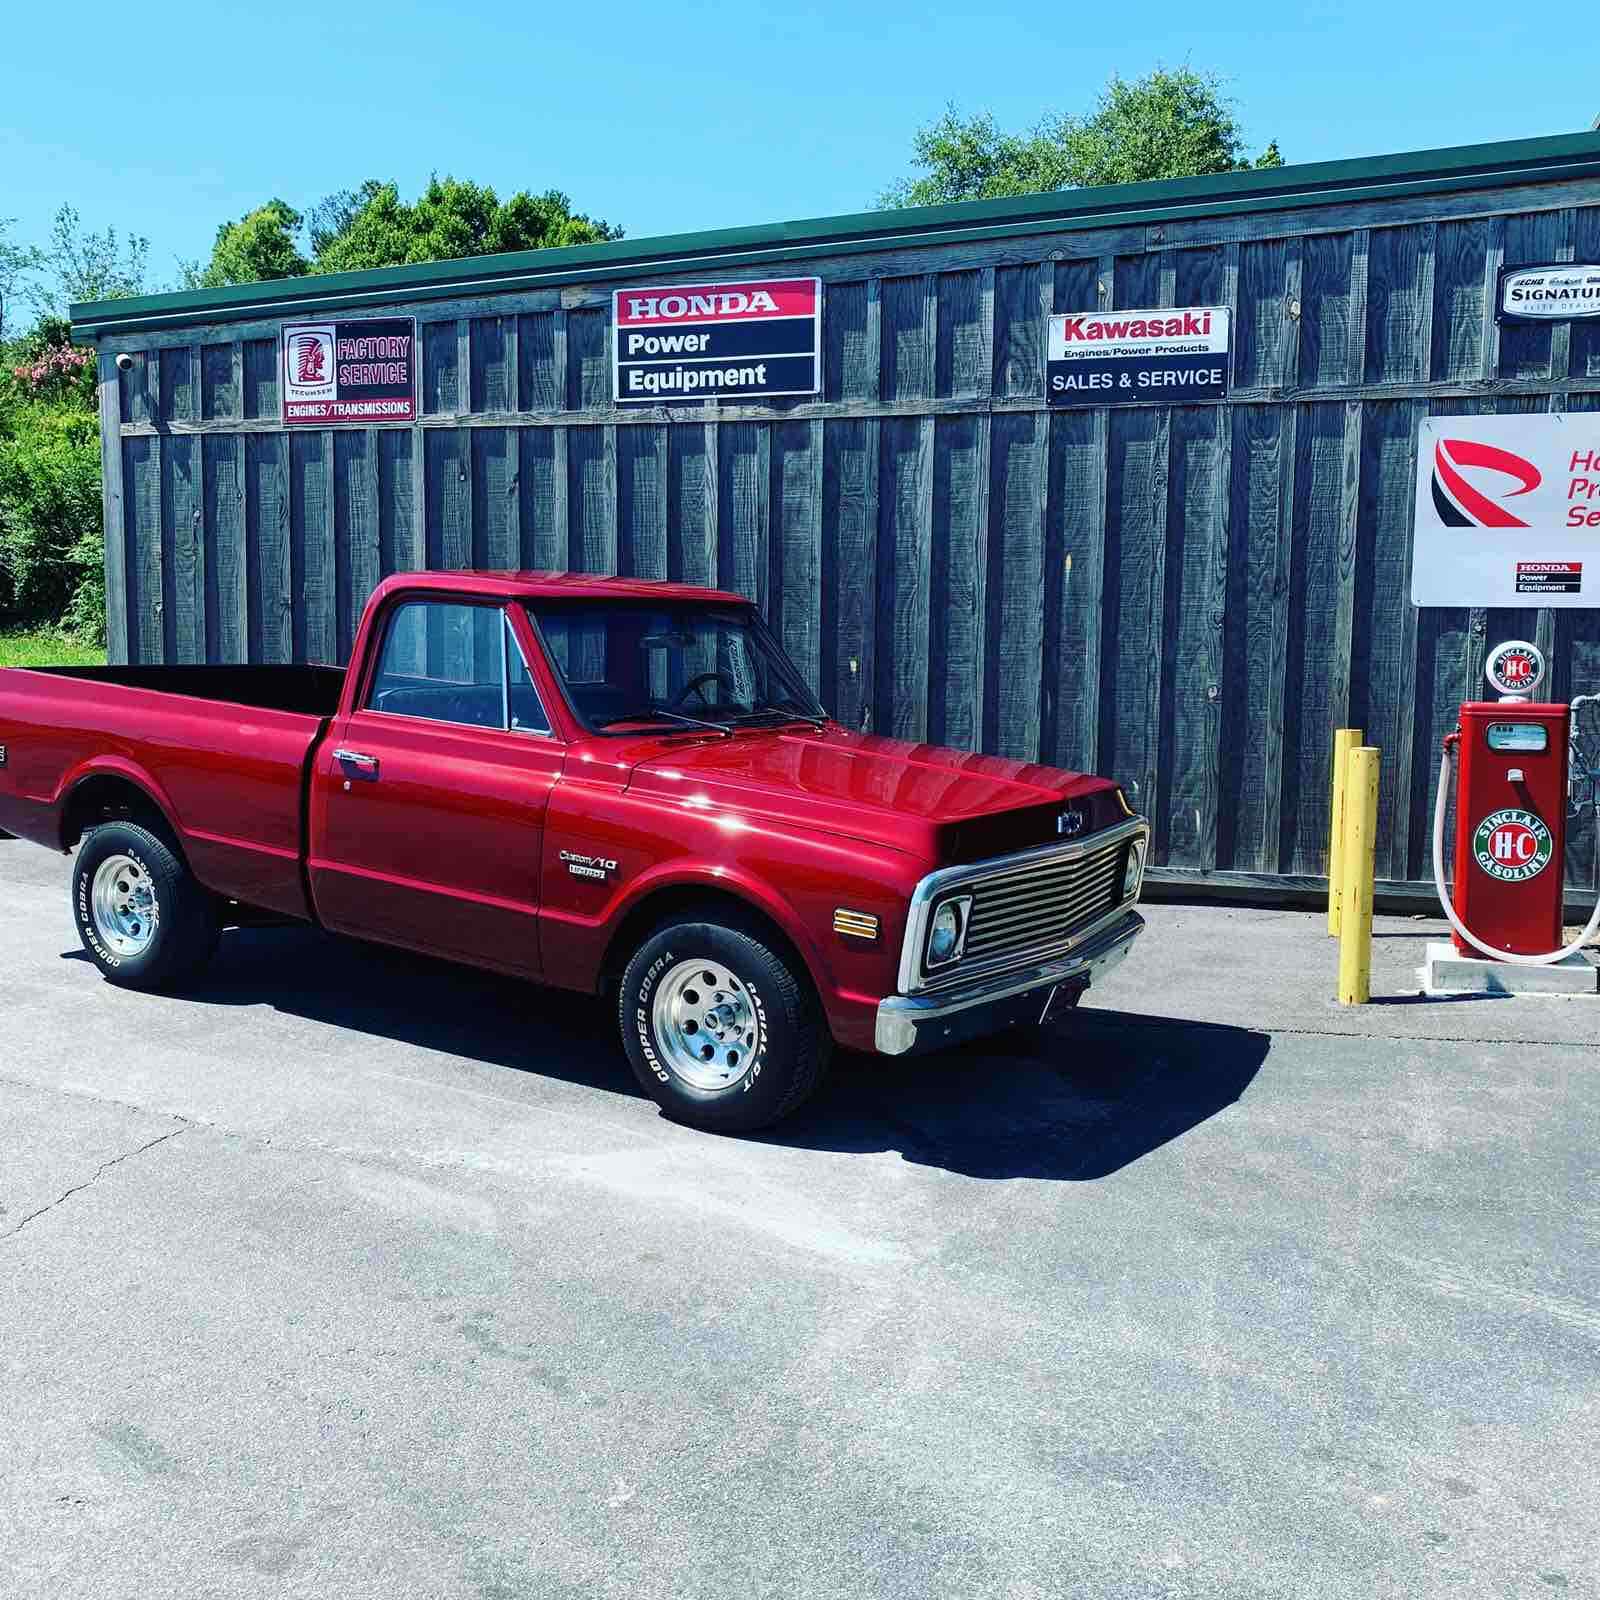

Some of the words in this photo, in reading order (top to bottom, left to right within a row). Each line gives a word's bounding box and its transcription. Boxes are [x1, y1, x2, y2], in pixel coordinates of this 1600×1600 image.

[627, 290, 779, 320] HONDA
[1064, 311, 1211, 342] Kawasaki
[337, 336, 410, 361] FACTORY
[628, 333, 710, 355] Power
[1155, 344, 1209, 354] Products
[339, 362, 408, 386] SERVICE
[628, 363, 767, 393] Equipment
[1052, 373, 1113, 391] SALES
[1119, 373, 1132, 387] &
[1137, 369, 1223, 386] SERVICE
[287, 401, 411, 417] ENGINES/TRANSMISSIONS
[1519, 574, 1548, 582] Power
[1520, 564, 1570, 572] HONDA
[1519, 583, 1566, 592] Equipment
[1479, 811, 1548, 841] SINCLAIR
[1478, 850, 1547, 879] GASOLINE
[79, 871, 89, 922] COBRA
[84, 926, 121, 968] COOPER
[639, 951, 674, 1002] COBRA
[637, 1008, 670, 1083] COOPER
